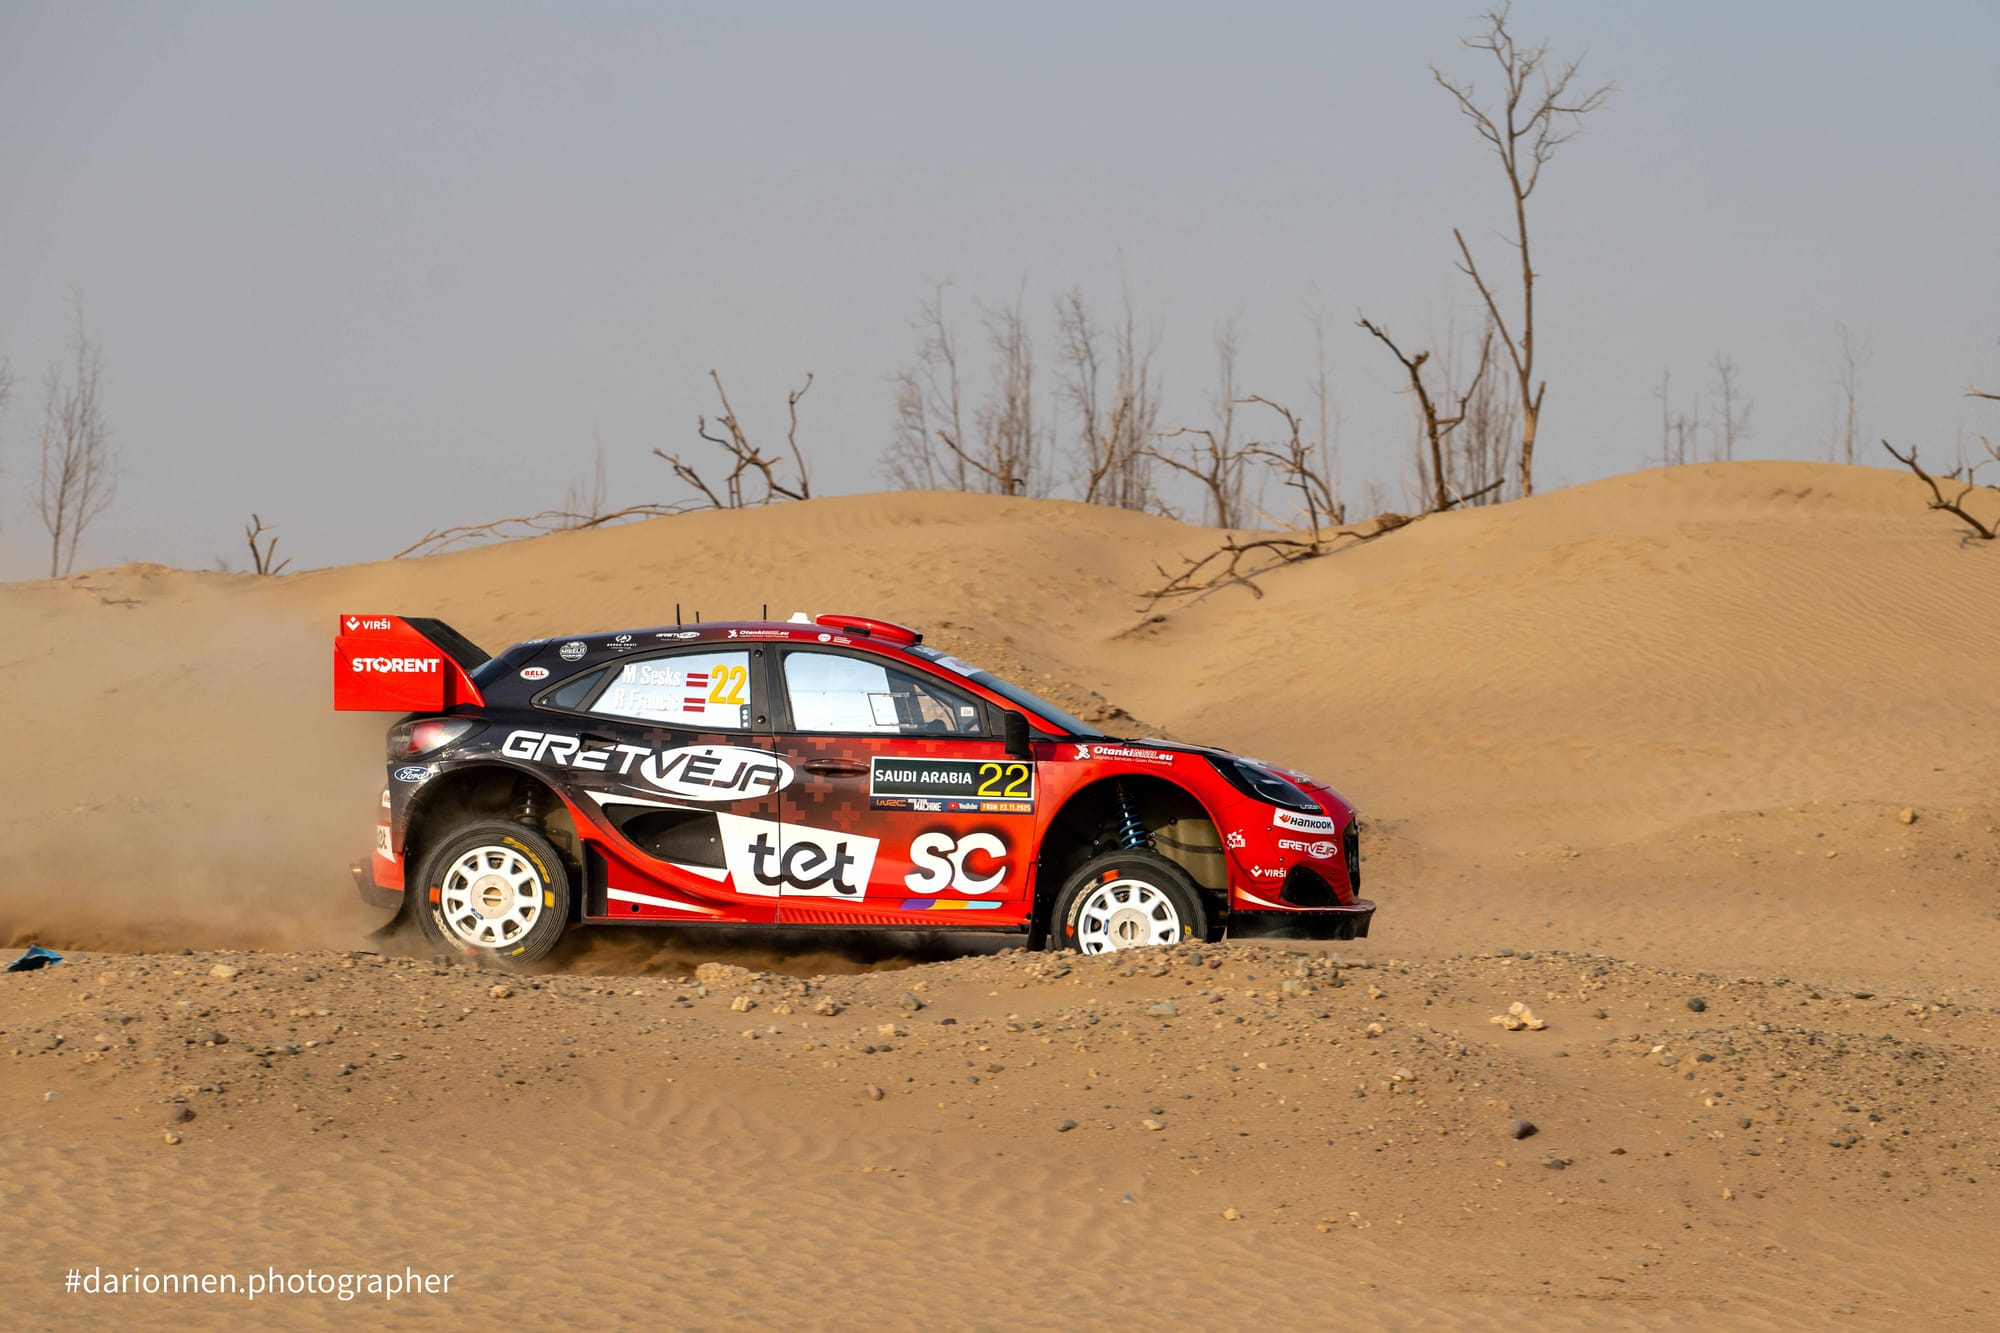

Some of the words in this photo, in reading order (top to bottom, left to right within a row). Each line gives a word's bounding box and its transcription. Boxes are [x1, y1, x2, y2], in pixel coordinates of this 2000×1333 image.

[362, 618, 391, 630] VIRŠI
[352, 657, 440, 673] STORENT
[623, 664, 636, 685] M
[640, 665, 682, 688] Sesks
[708, 664, 747, 705] 22
[875, 769, 917, 783] SAUDI
[920, 771, 972, 785] ARABIA
[977, 762, 1029, 797] 22
[748, 833, 858, 894] tet
[904, 832, 1007, 895] SC
[1264, 868, 1287, 878] VIRŠI
